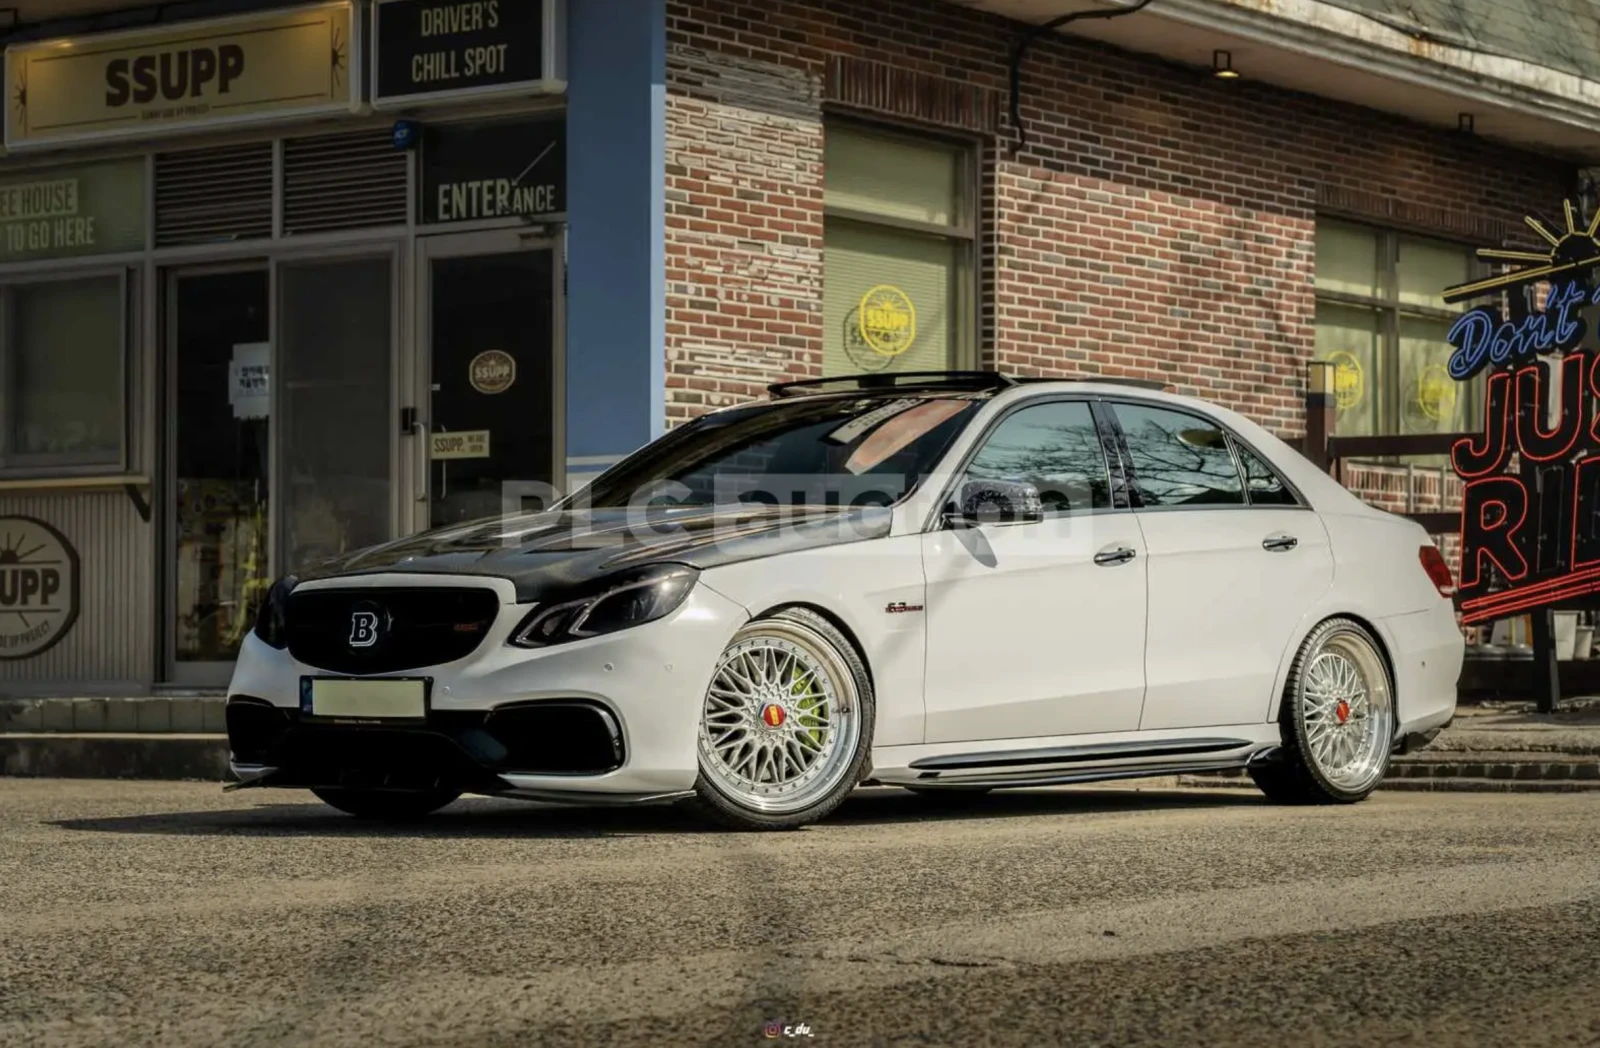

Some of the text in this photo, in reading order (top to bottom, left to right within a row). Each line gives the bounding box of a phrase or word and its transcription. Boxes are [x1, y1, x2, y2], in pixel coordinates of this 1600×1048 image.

[421, 1, 500, 37] DRIVER'S
[105, 44, 246, 108] SSUPP
[411, 44, 509, 83] CHILL SPOT
[22, 183, 73, 216] HOUSE
[6, 216, 96, 251] TO GO HERE
[475, 365, 510, 379] SSUPP
[1450, 351, 1600, 478] JU
[0, 568, 60, 605] UPP
[348, 611, 379, 648] B
